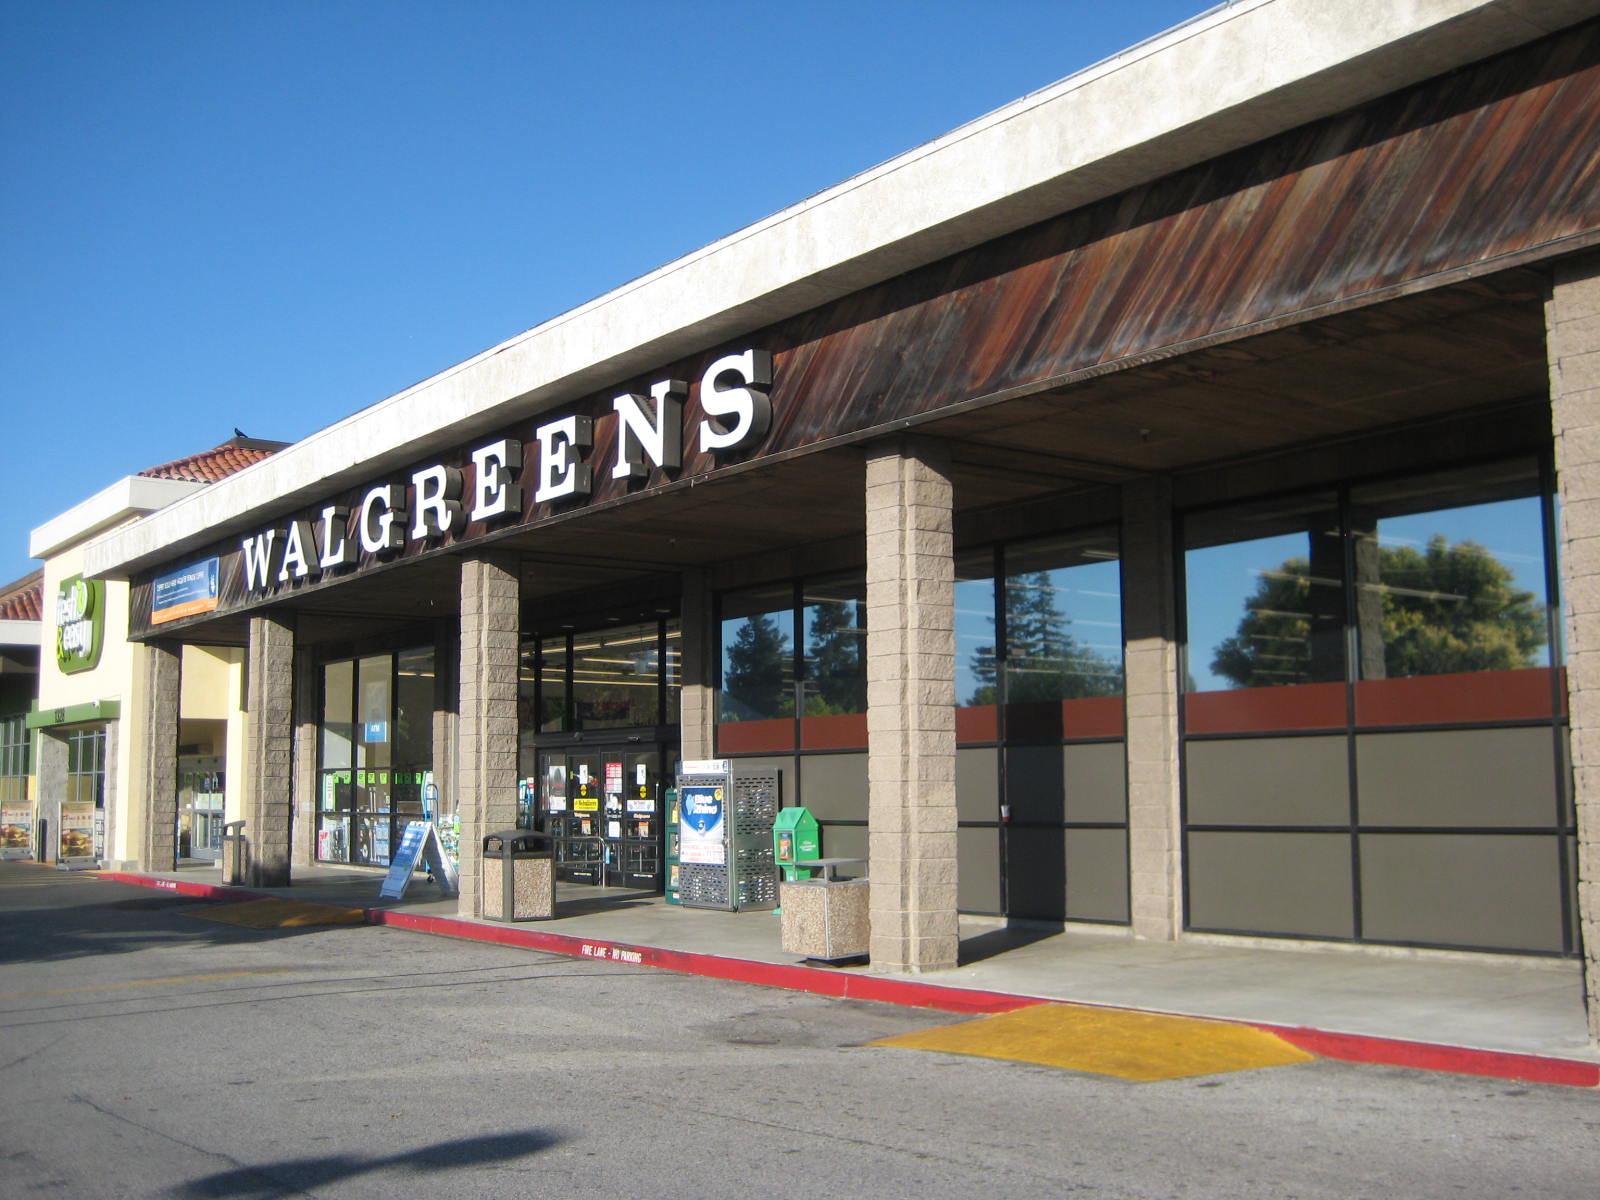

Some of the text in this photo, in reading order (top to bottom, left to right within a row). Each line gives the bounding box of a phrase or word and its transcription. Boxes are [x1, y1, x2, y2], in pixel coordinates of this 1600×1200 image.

[242, 349, 762, 592] WALGREENS
[581, 944, 593, 956] FIRE
[594, 946, 607, 958] LANE
[612, 947, 619, 960] NO
[620, 950, 642, 964] PARKING
